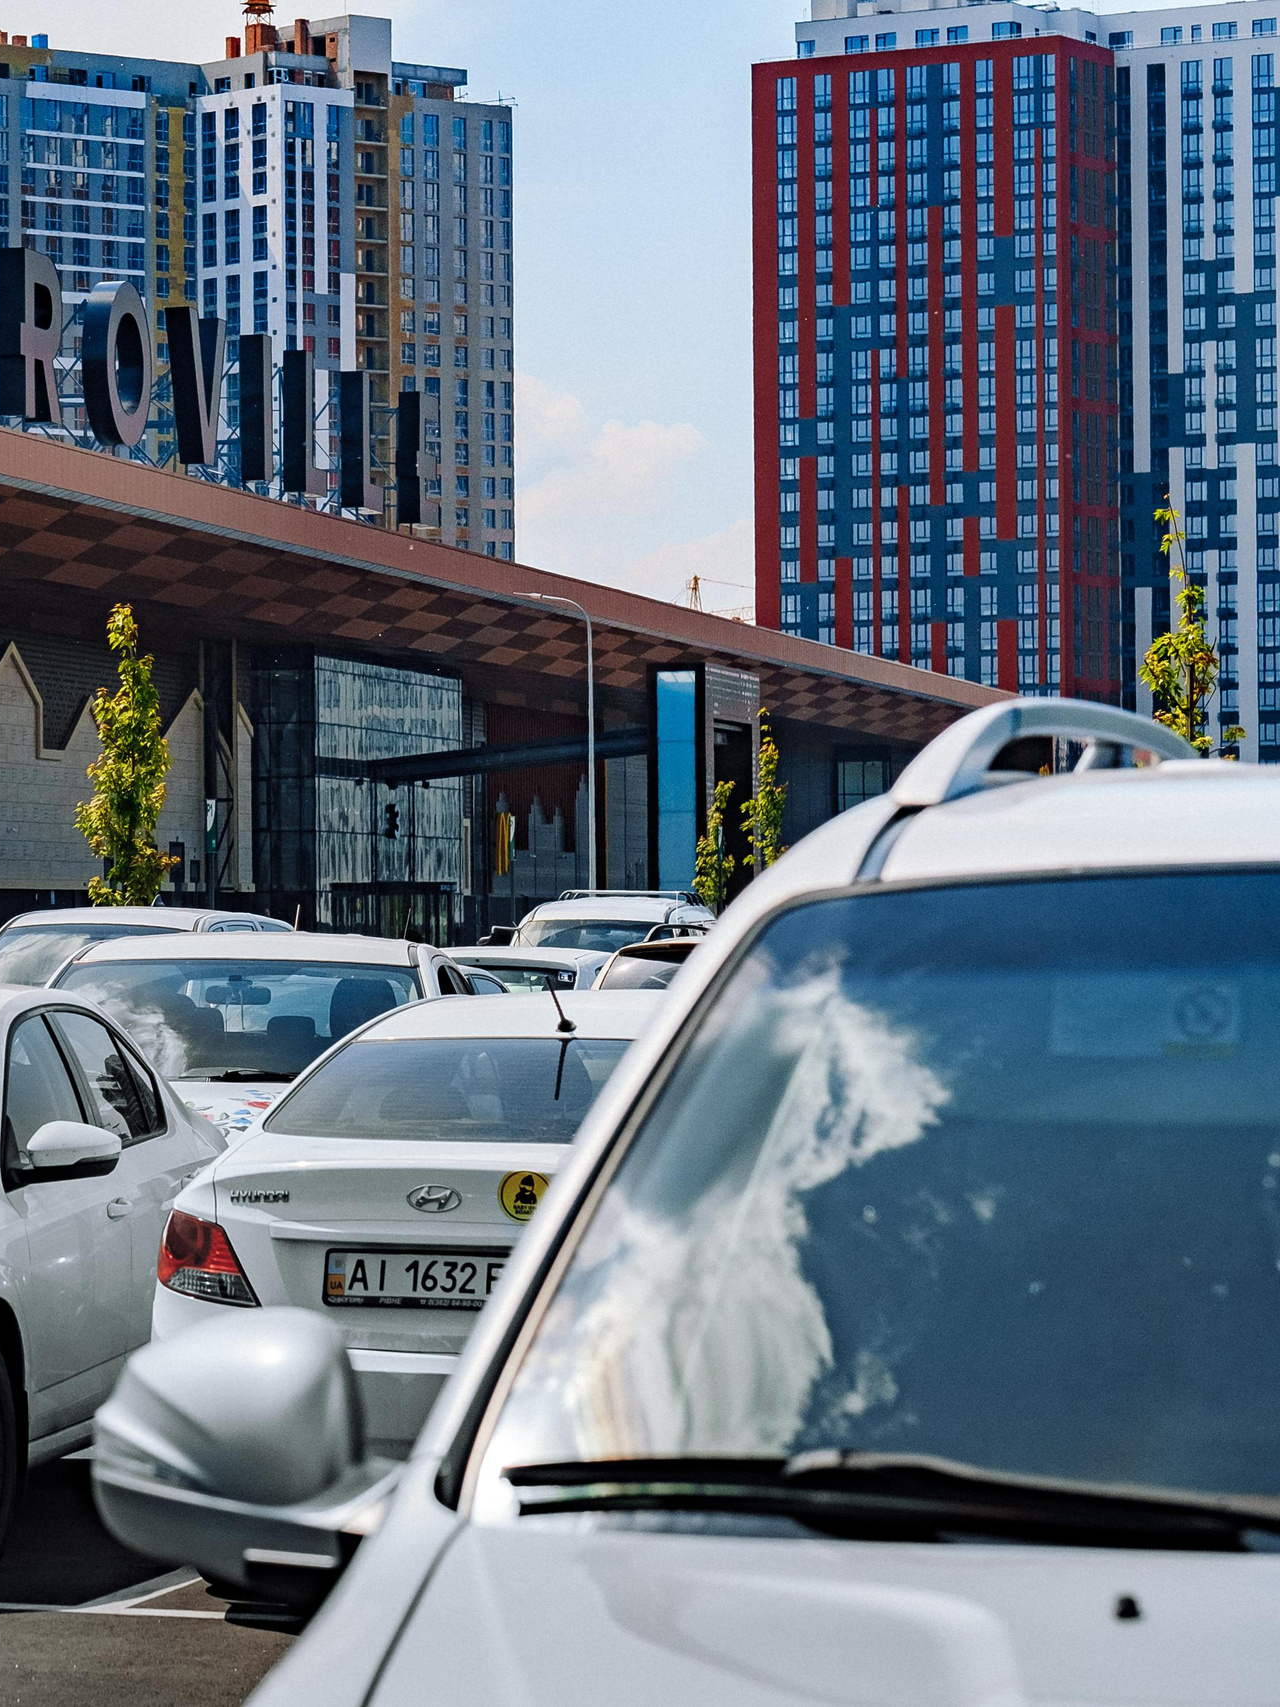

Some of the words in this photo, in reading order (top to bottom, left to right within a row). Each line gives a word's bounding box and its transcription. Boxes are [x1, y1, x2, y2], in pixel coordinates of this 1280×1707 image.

[230, 1189, 290, 1203] HYUNDAI
[348, 1259, 387, 1291] AI
[405, 1260, 477, 1295] 1632
[330, 1281, 344, 1290] UA
